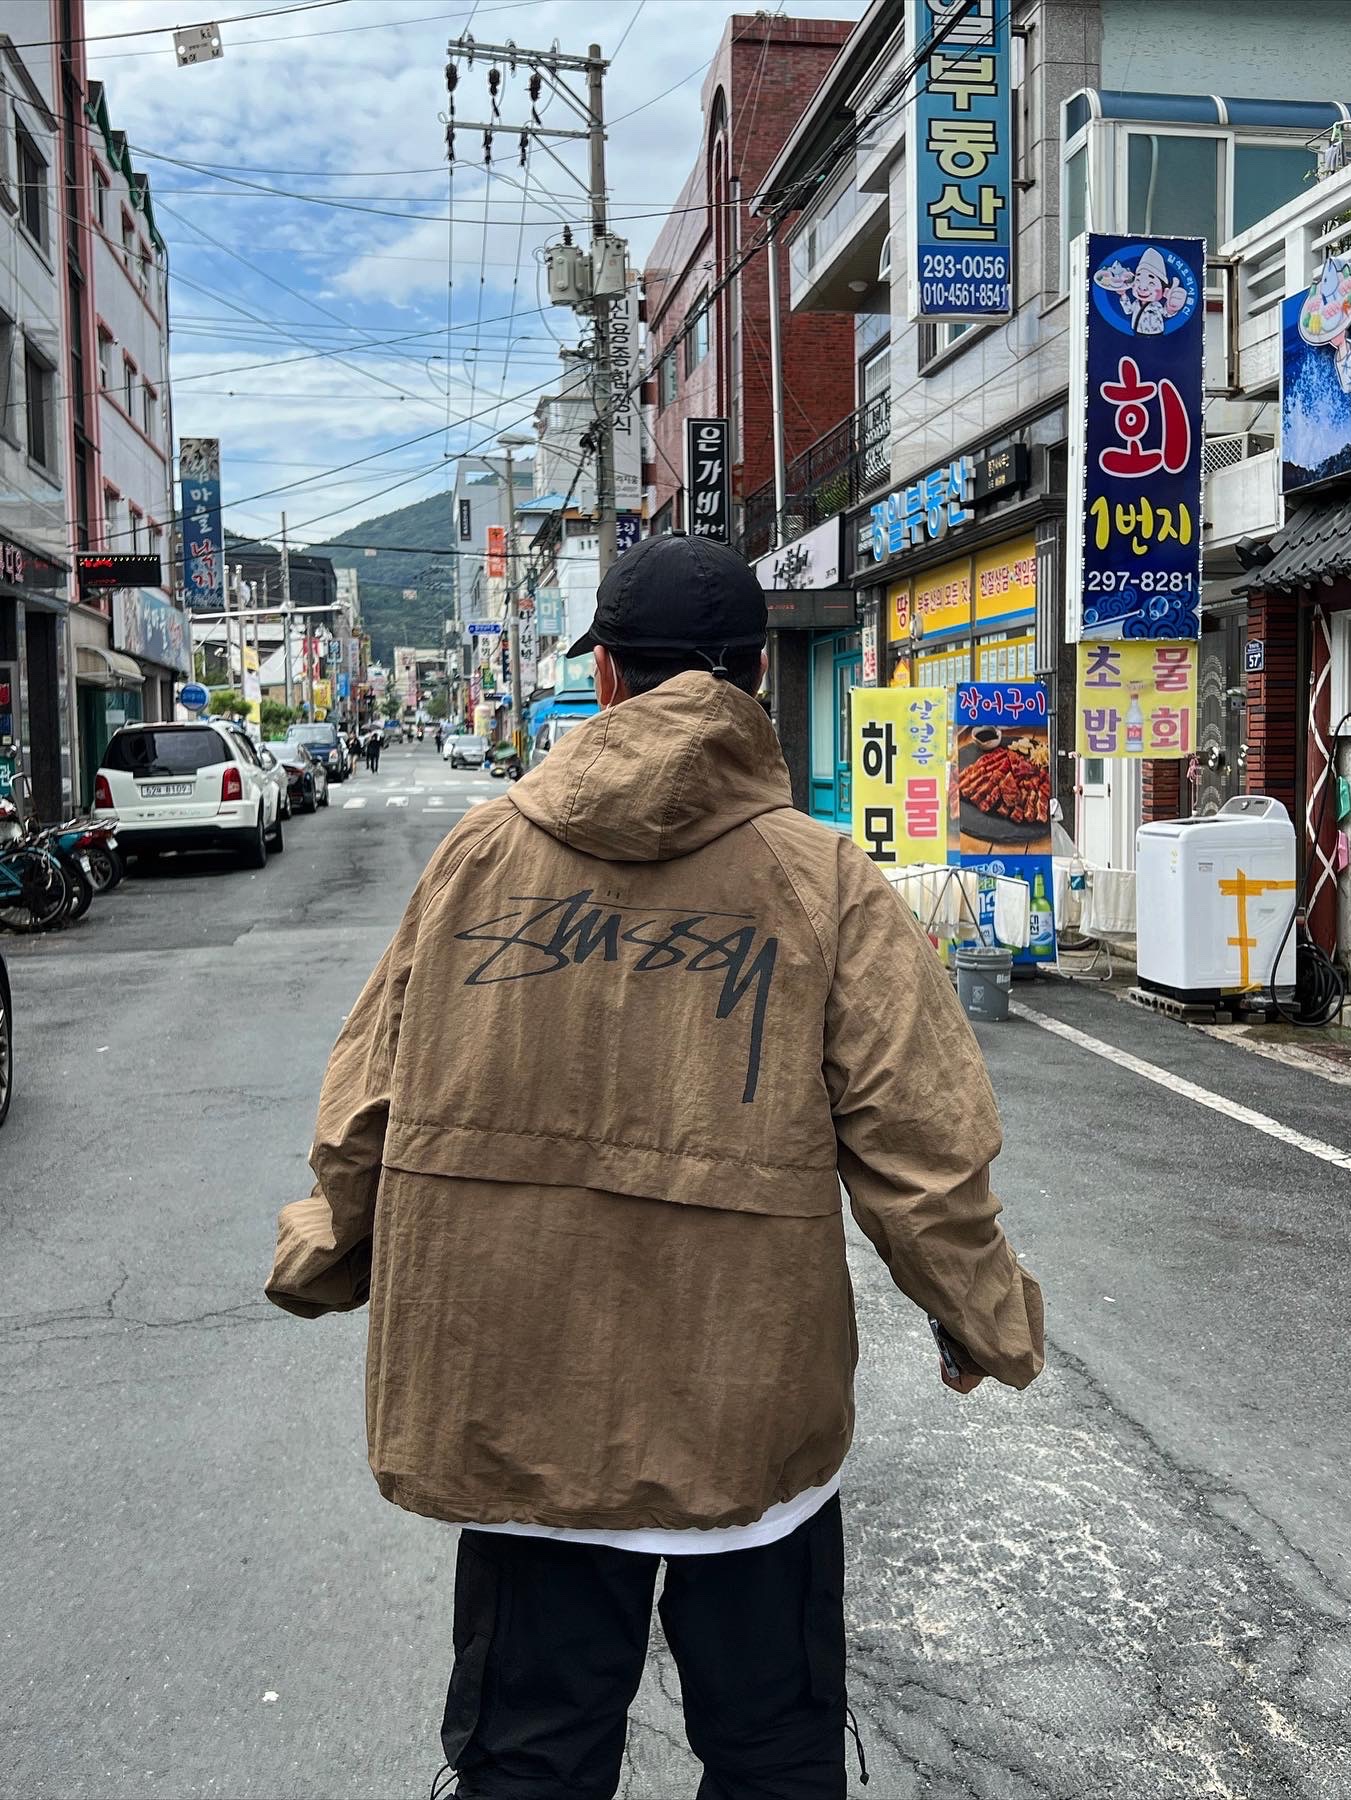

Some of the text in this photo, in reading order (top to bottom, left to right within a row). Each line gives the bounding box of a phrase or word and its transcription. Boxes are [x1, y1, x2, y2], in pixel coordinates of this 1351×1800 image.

[923, 254, 1005, 279] 293-0056
[923, 282, 1006, 306] 010-4561-8541
[1099, 355, 1191, 478] 회
[695, 426, 722, 517] 은가비
[870, 455, 971, 562] 정일부동산
[1090, 495, 1193, 556] 1번지
[896, 593, 909, 629] 땅
[1087, 570, 1193, 592] 297-8281
[960, 687, 1047, 720] 장어구이
[1082, 645, 1122, 753] 초밥
[1149, 647, 1192, 752] 물회
[909, 699, 939, 766] 살얼음
[861, 721, 897, 862] 하모
[905, 778, 940, 838] 물
